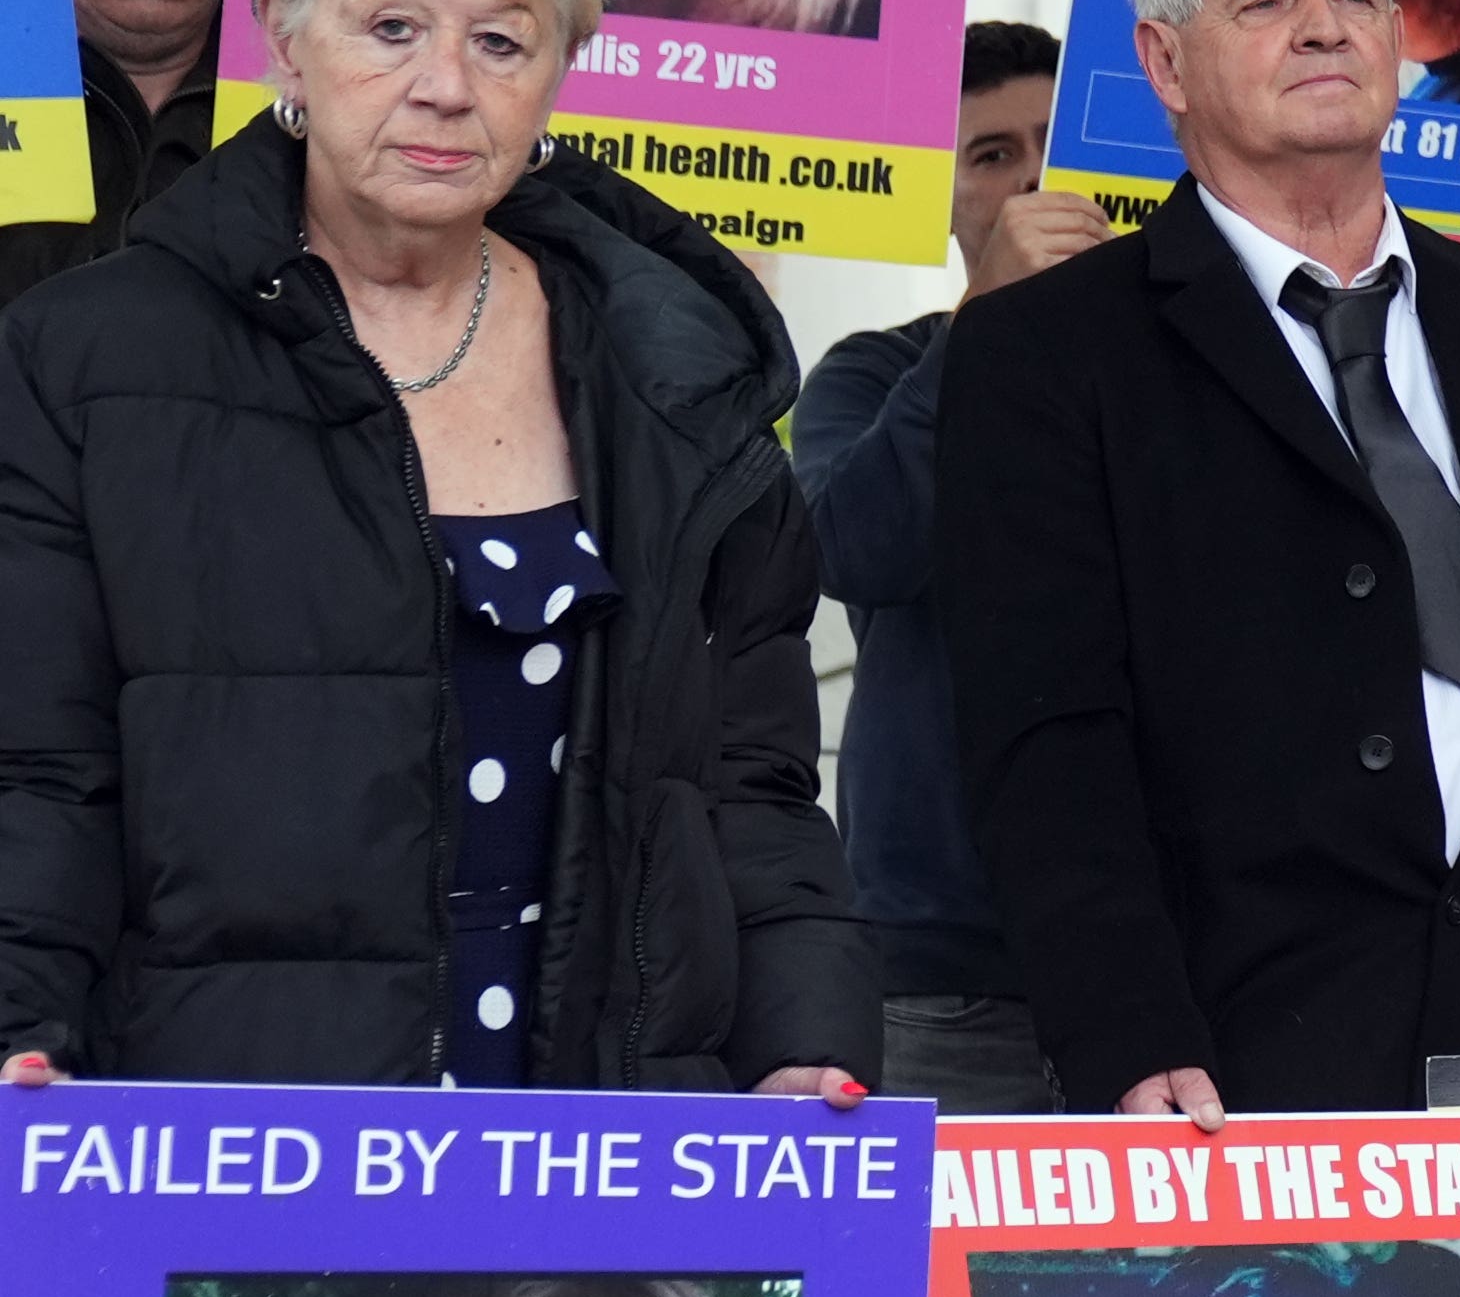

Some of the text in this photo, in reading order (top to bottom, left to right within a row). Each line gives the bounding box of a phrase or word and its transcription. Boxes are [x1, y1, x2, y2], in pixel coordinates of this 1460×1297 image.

[1417, 120, 1458, 160] 81
[21, 1123, 898, 1200] FAILED BY THE STATE
